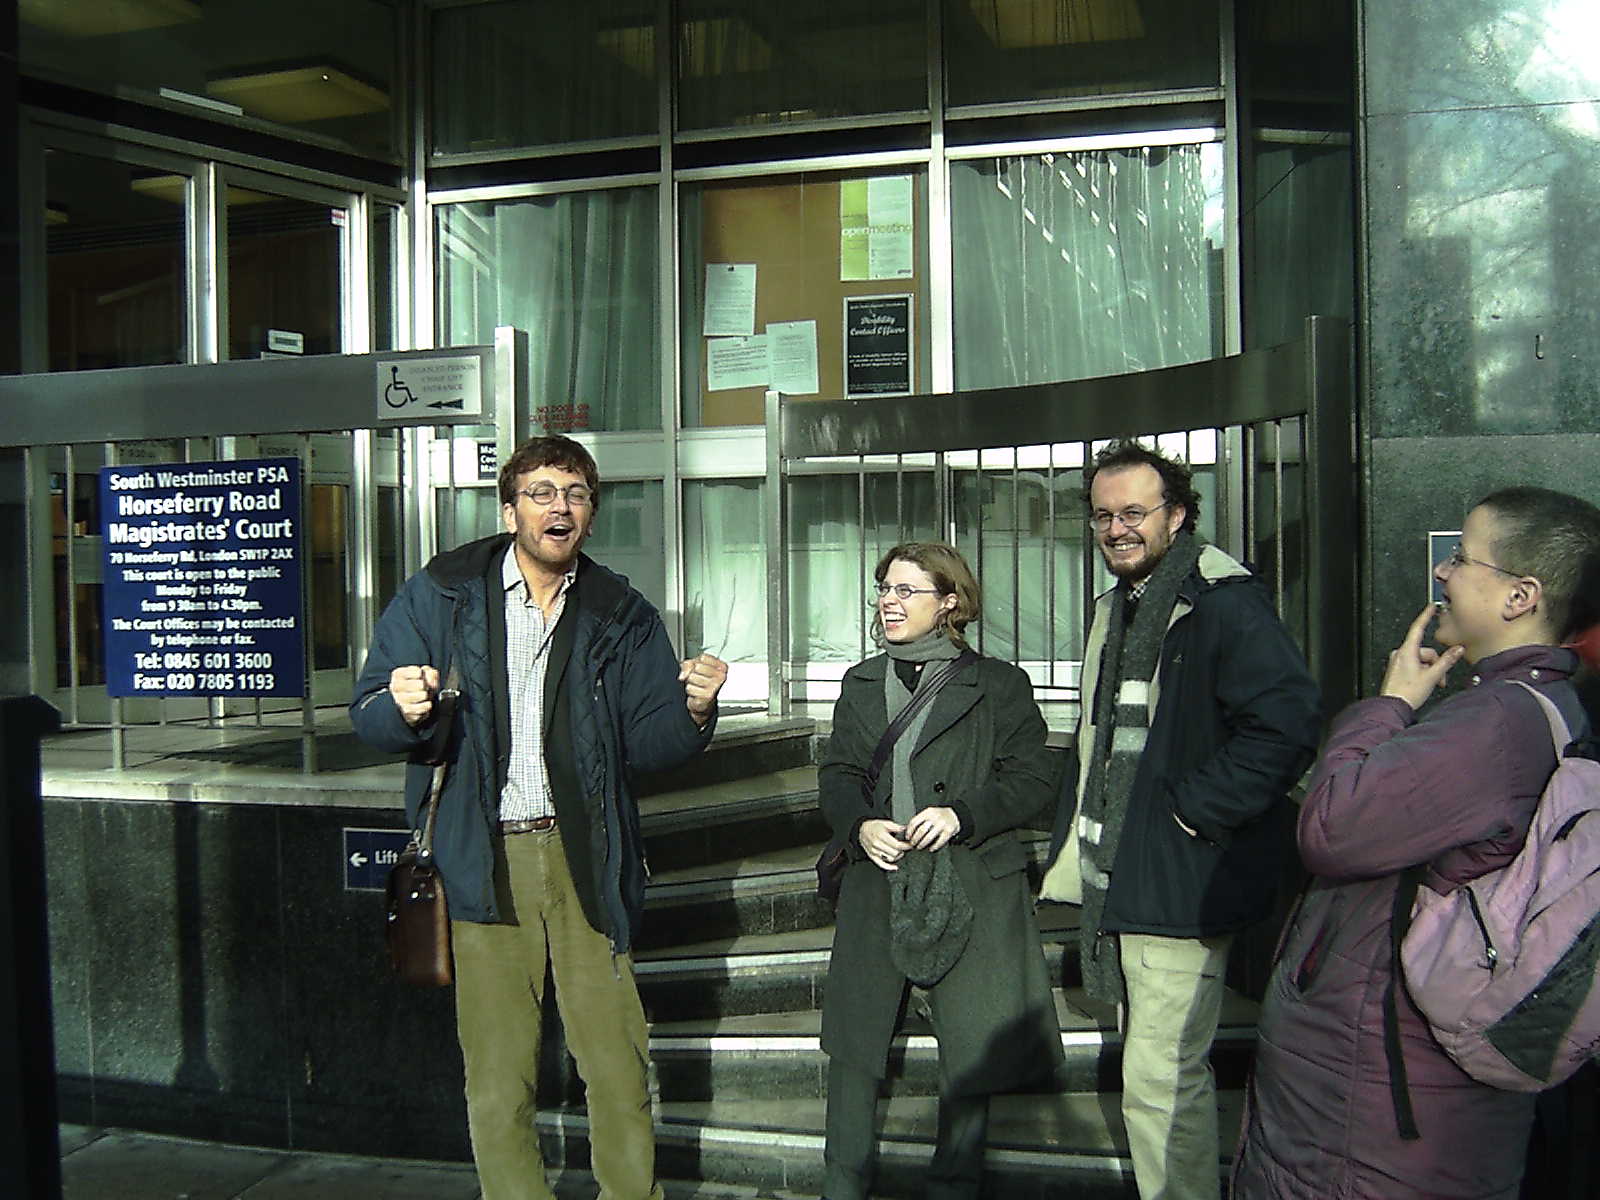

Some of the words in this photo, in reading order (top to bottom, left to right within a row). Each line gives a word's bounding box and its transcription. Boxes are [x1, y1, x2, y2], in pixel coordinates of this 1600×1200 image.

[110, 472, 154, 490] South
[157, 469, 254, 487] Westminster
[257, 467, 289, 483] PSA
[119, 492, 224, 517] Horseferry
[229, 488, 281, 511] Road
[109, 518, 231, 547] Magistrates'
[235, 519, 292, 539] Court
[124, 551, 179, 566] Horseferry
[199, 550, 237, 561] London
[239, 549, 269, 561] SW1P
[271, 548, 293, 560] 2AX
[122, 569, 144, 581] This
[145, 569, 173, 581] court
[174, 569, 184, 581] is
[186, 570, 212, 582] open
[214, 569, 226, 580] to
[228, 568, 246, 580] the
[248, 567, 281, 581] public
[155, 583, 198, 598] Monday
[200, 585, 212, 595] to
[213, 583, 247, 597] Friday
[141, 600, 167, 611] from
[207, 601, 220, 611] to
[112, 618, 132, 631] The
[133, 618, 163, 630] Court
[164, 617, 200, 630] Offices
[201, 620, 224, 632] may
[226, 617, 240, 629] be
[241, 616, 295, 629] contacted
[151, 634, 164, 648] by
[166, 633, 218, 648] telephone
[220, 635, 233, 645] or
[234, 633, 256, 645] fax.
[135, 652, 162, 669] Tel:
[164, 653, 200, 669] 0845
[203, 653, 231, 669] 601
[235, 653, 272, 669] 3600
[134, 674, 165, 690] Fax:
[166, 674, 196, 690] 020
[198, 674, 234, 690] 7805
[238, 674, 275, 690] 1193
[375, 849, 398, 865] Lift
